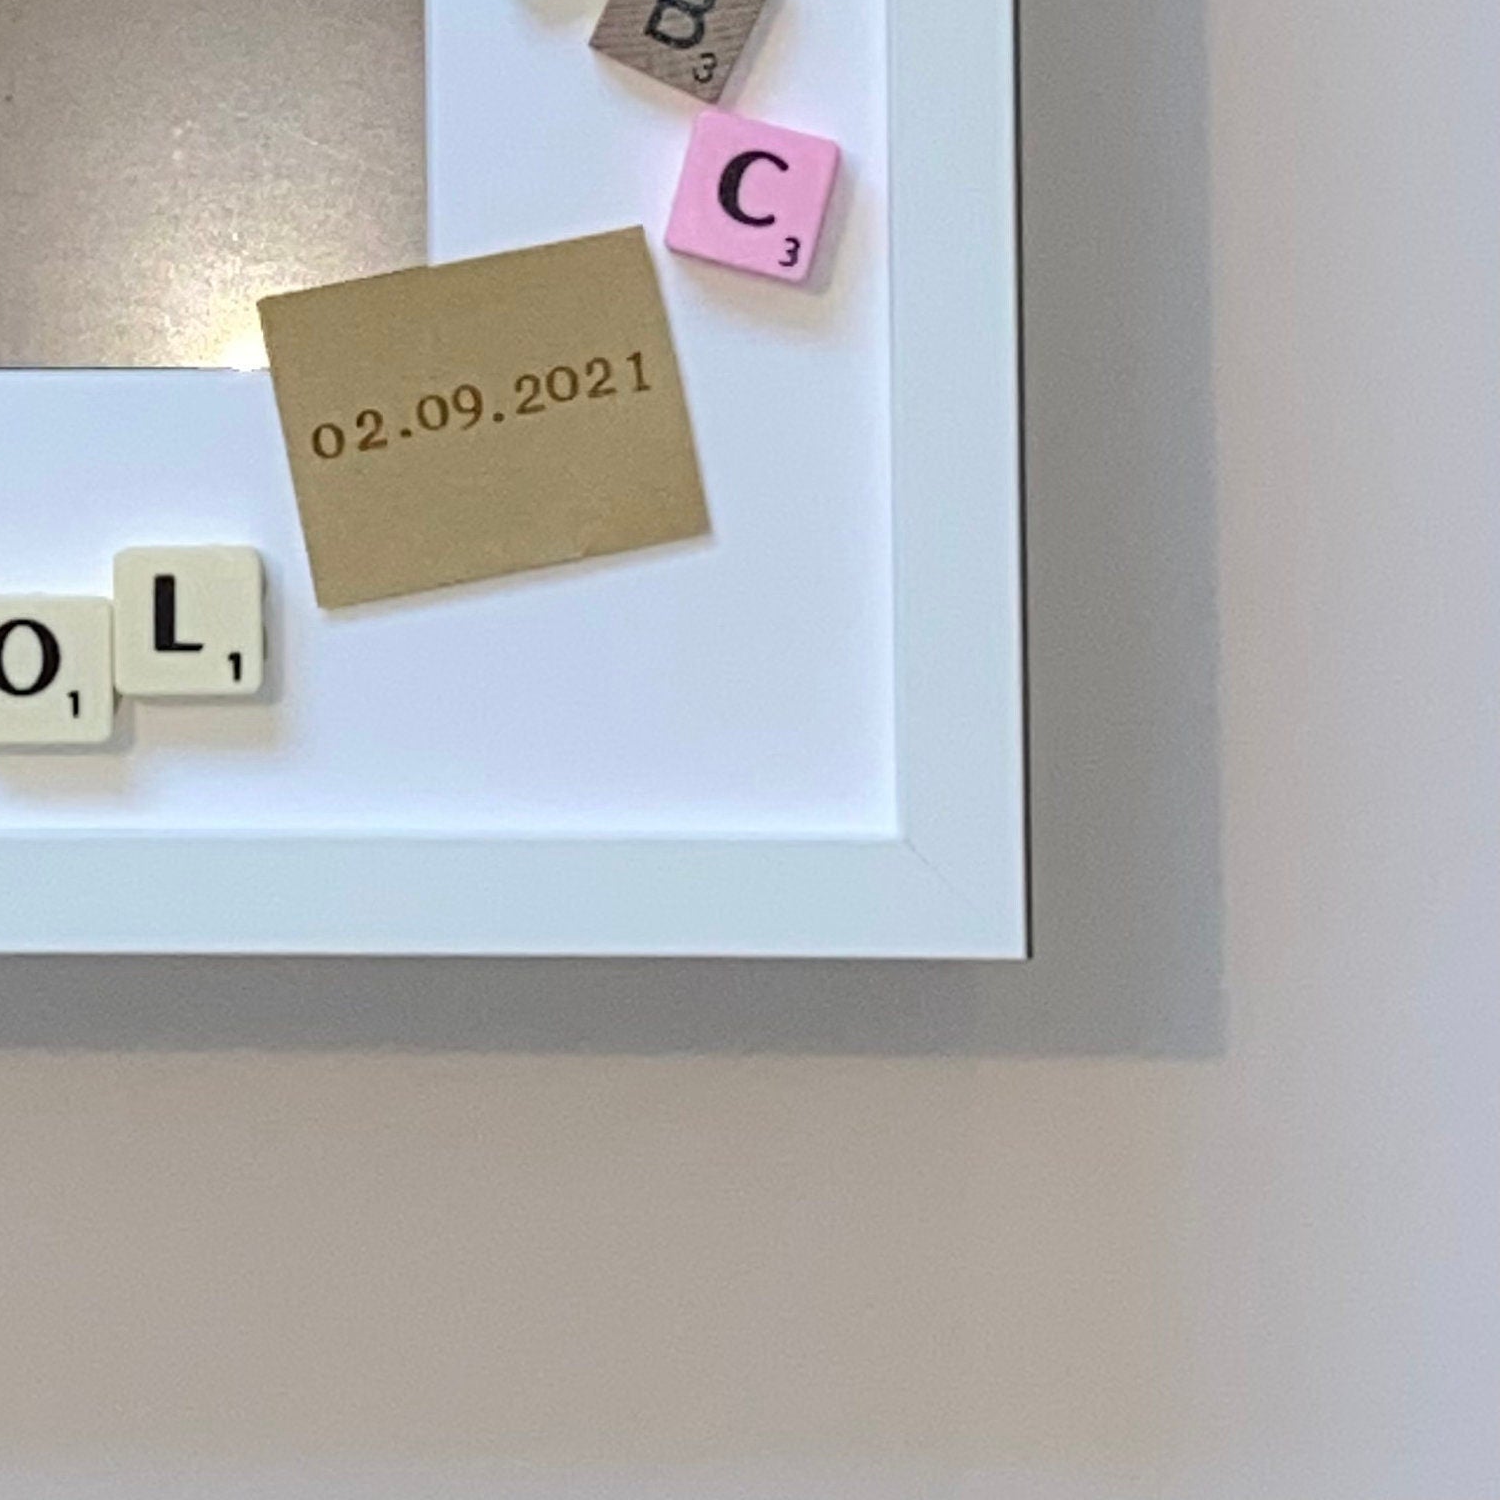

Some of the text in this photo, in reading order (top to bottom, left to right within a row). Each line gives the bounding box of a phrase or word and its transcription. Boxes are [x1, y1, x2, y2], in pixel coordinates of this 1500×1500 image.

[692, 52, 718, 85] 3
[717, 150, 790, 228] C
[777, 236, 801, 267] 3
[311, 350, 652, 461] 02.09.2021
[67, 689, 81, 719] 1
[226, 651, 243, 682] 1
